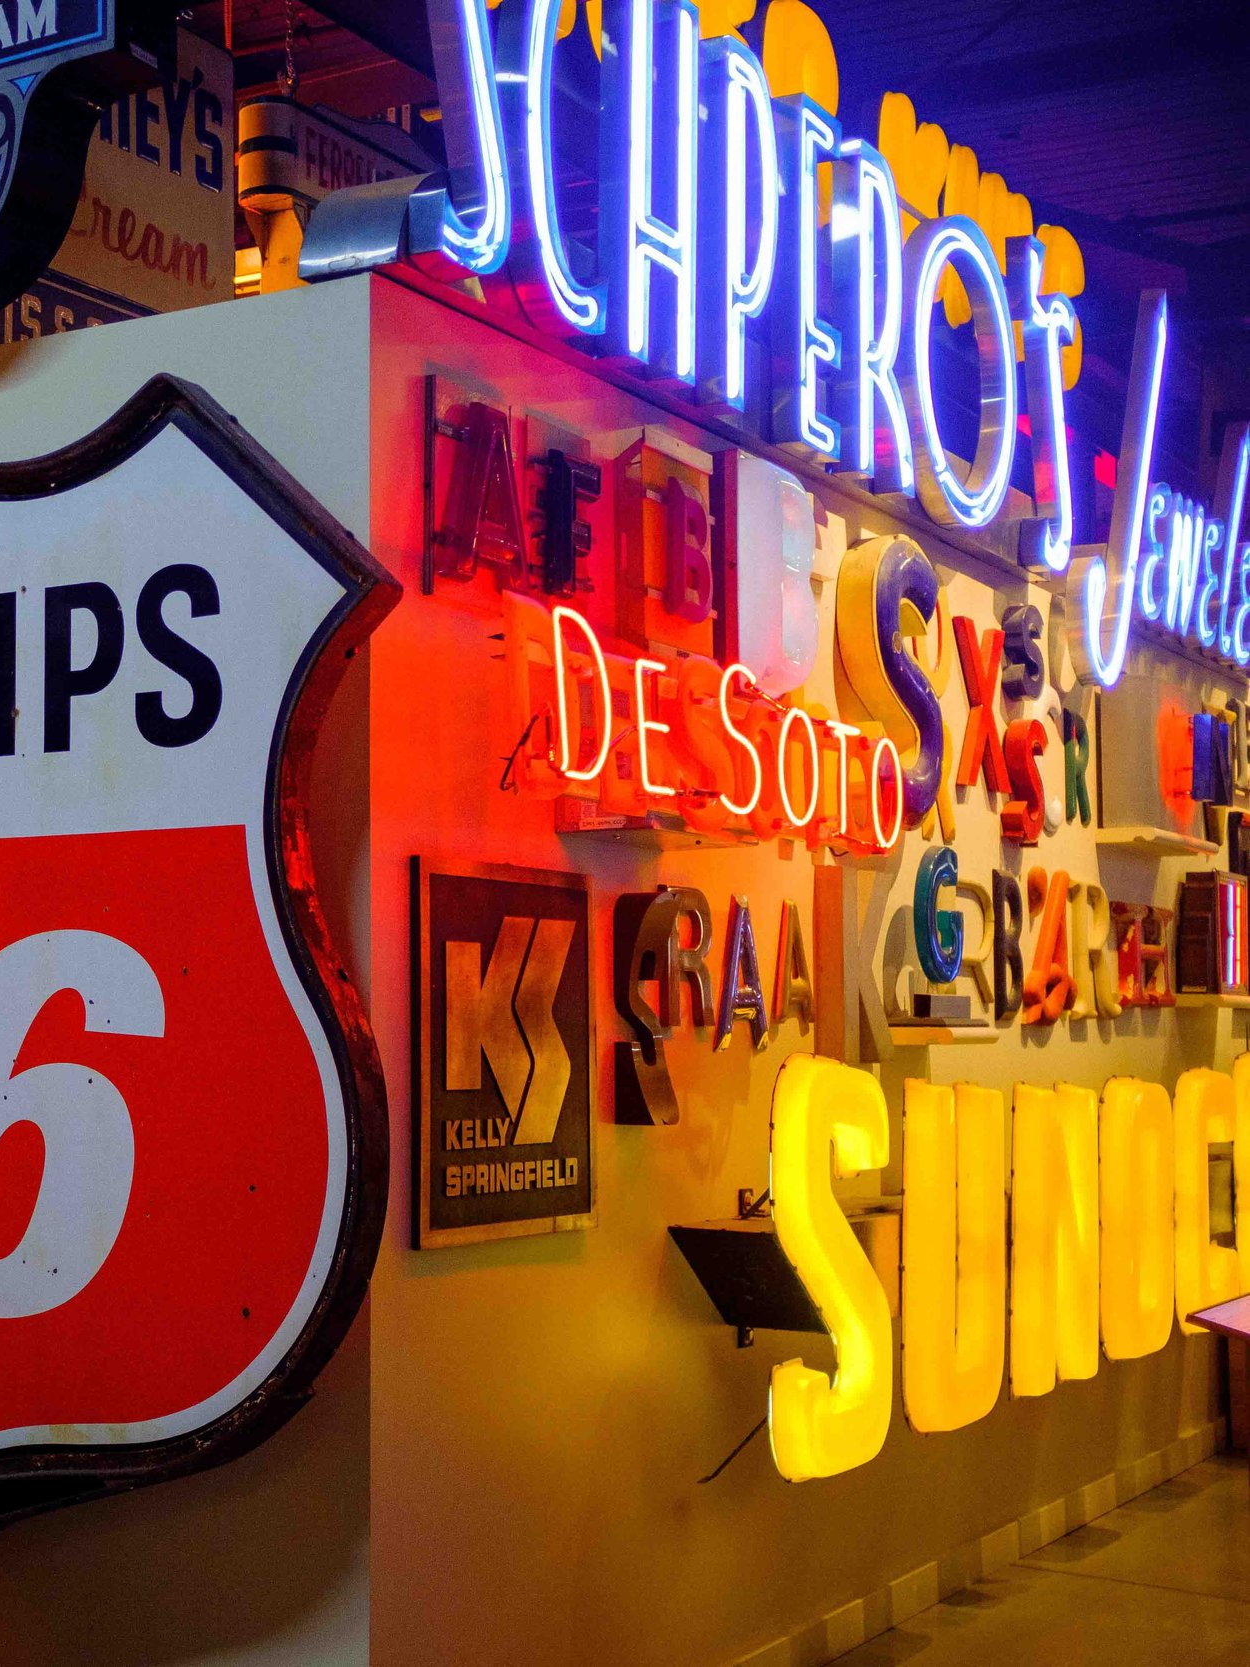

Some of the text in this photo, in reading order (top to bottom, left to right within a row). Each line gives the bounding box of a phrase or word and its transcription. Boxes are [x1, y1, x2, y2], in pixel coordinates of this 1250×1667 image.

[719, 662, 903, 849] SOTO
[445, 1117, 511, 1150] KELLY
[445, 1157, 579, 1197] SPRINGFIELD
[768, 1050, 1250, 1482] SUNOC
